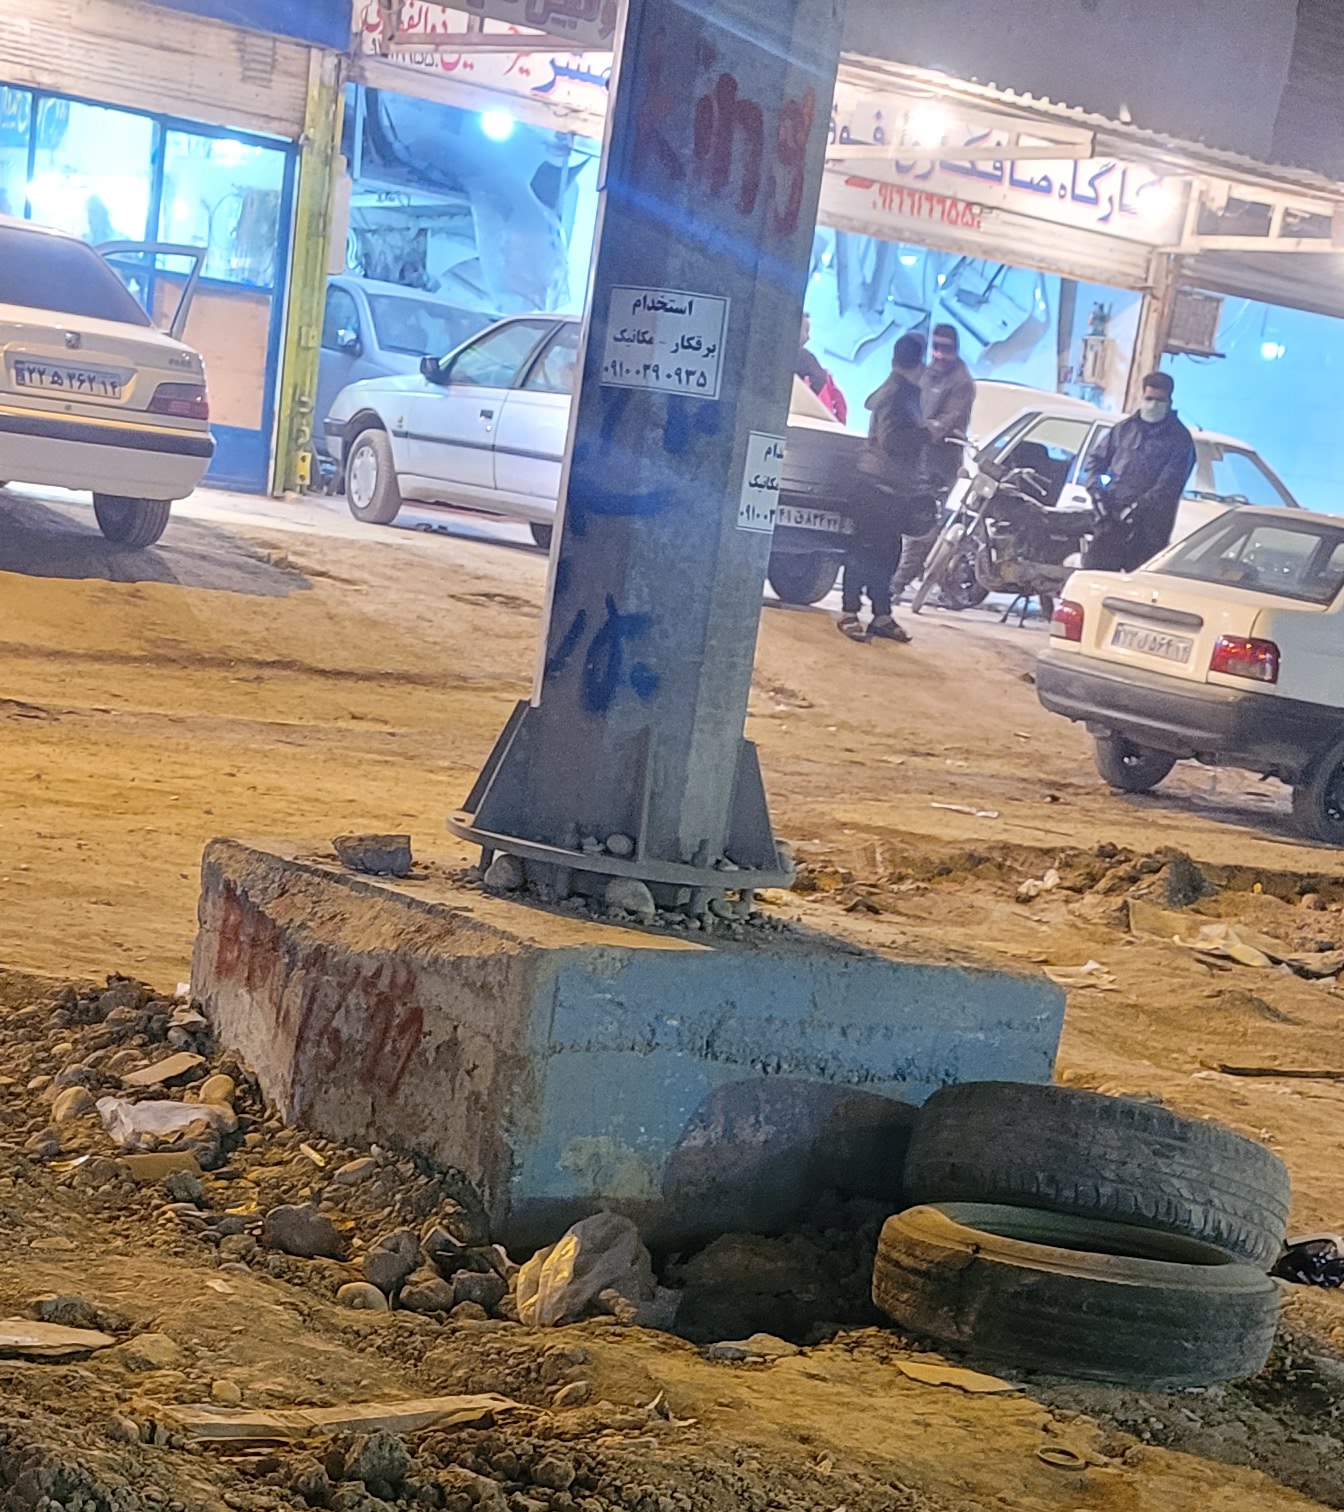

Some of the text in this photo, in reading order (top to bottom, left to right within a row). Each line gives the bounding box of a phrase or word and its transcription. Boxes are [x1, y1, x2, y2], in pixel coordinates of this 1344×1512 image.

[896, 122, 1053, 195] صافکری
[632, 294, 693, 316] استخدام
[613, 328, 654, 347] مکانیک
[670, 334, 716, 358] برقکار
[27, 366, 46, 385] ۲۲
[101, 380, 119, 396] ۱۴
[740, 504, 776, 524] ۰۹۱۰۰۳
